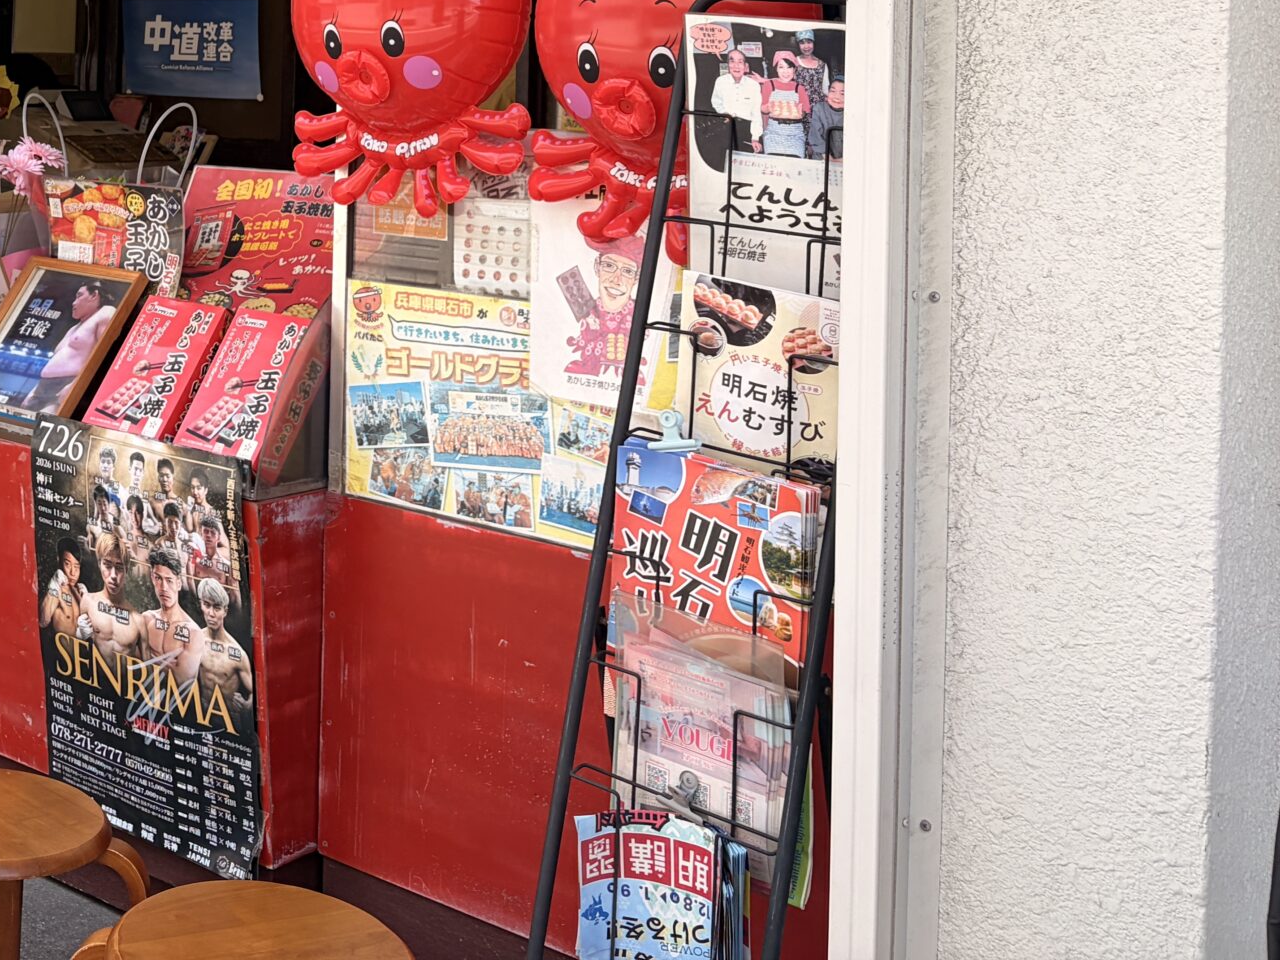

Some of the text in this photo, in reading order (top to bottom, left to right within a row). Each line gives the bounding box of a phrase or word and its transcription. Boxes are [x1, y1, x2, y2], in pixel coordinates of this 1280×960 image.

[144, 14, 201, 61] 中道
[203, 21, 234, 42] 改革
[202, 42, 234, 62] 連合
[360, 132, 388, 153] Tako
[216, 178, 325, 201] 全国初! あかし
[730, 181, 839, 212] てんしん
[147, 194, 170, 281] あかし
[394, 291, 488, 319] 兵庫県明石市 が
[721, 372, 799, 412] 明石焼
[695, 392, 827, 442] えんむすび
[38, 421, 84, 462] 7.26
[35, 456, 52, 469] 2026
[36, 471, 53, 486] 神戸
[36, 486, 84, 508] 芸術センター
[53, 507, 70, 520] 11:30
[53, 519, 70, 532] 12:00
[50, 677, 73, 694] SUPER
[54, 632, 240, 736] SENRIMA
[51, 689, 74, 705] FIGHT
[89, 693, 115, 711] FIGHT
[88, 704, 117, 724] TO THE
[81, 713, 127, 739] NEXT STAGE
[186, 851, 211, 868] JAPAN
